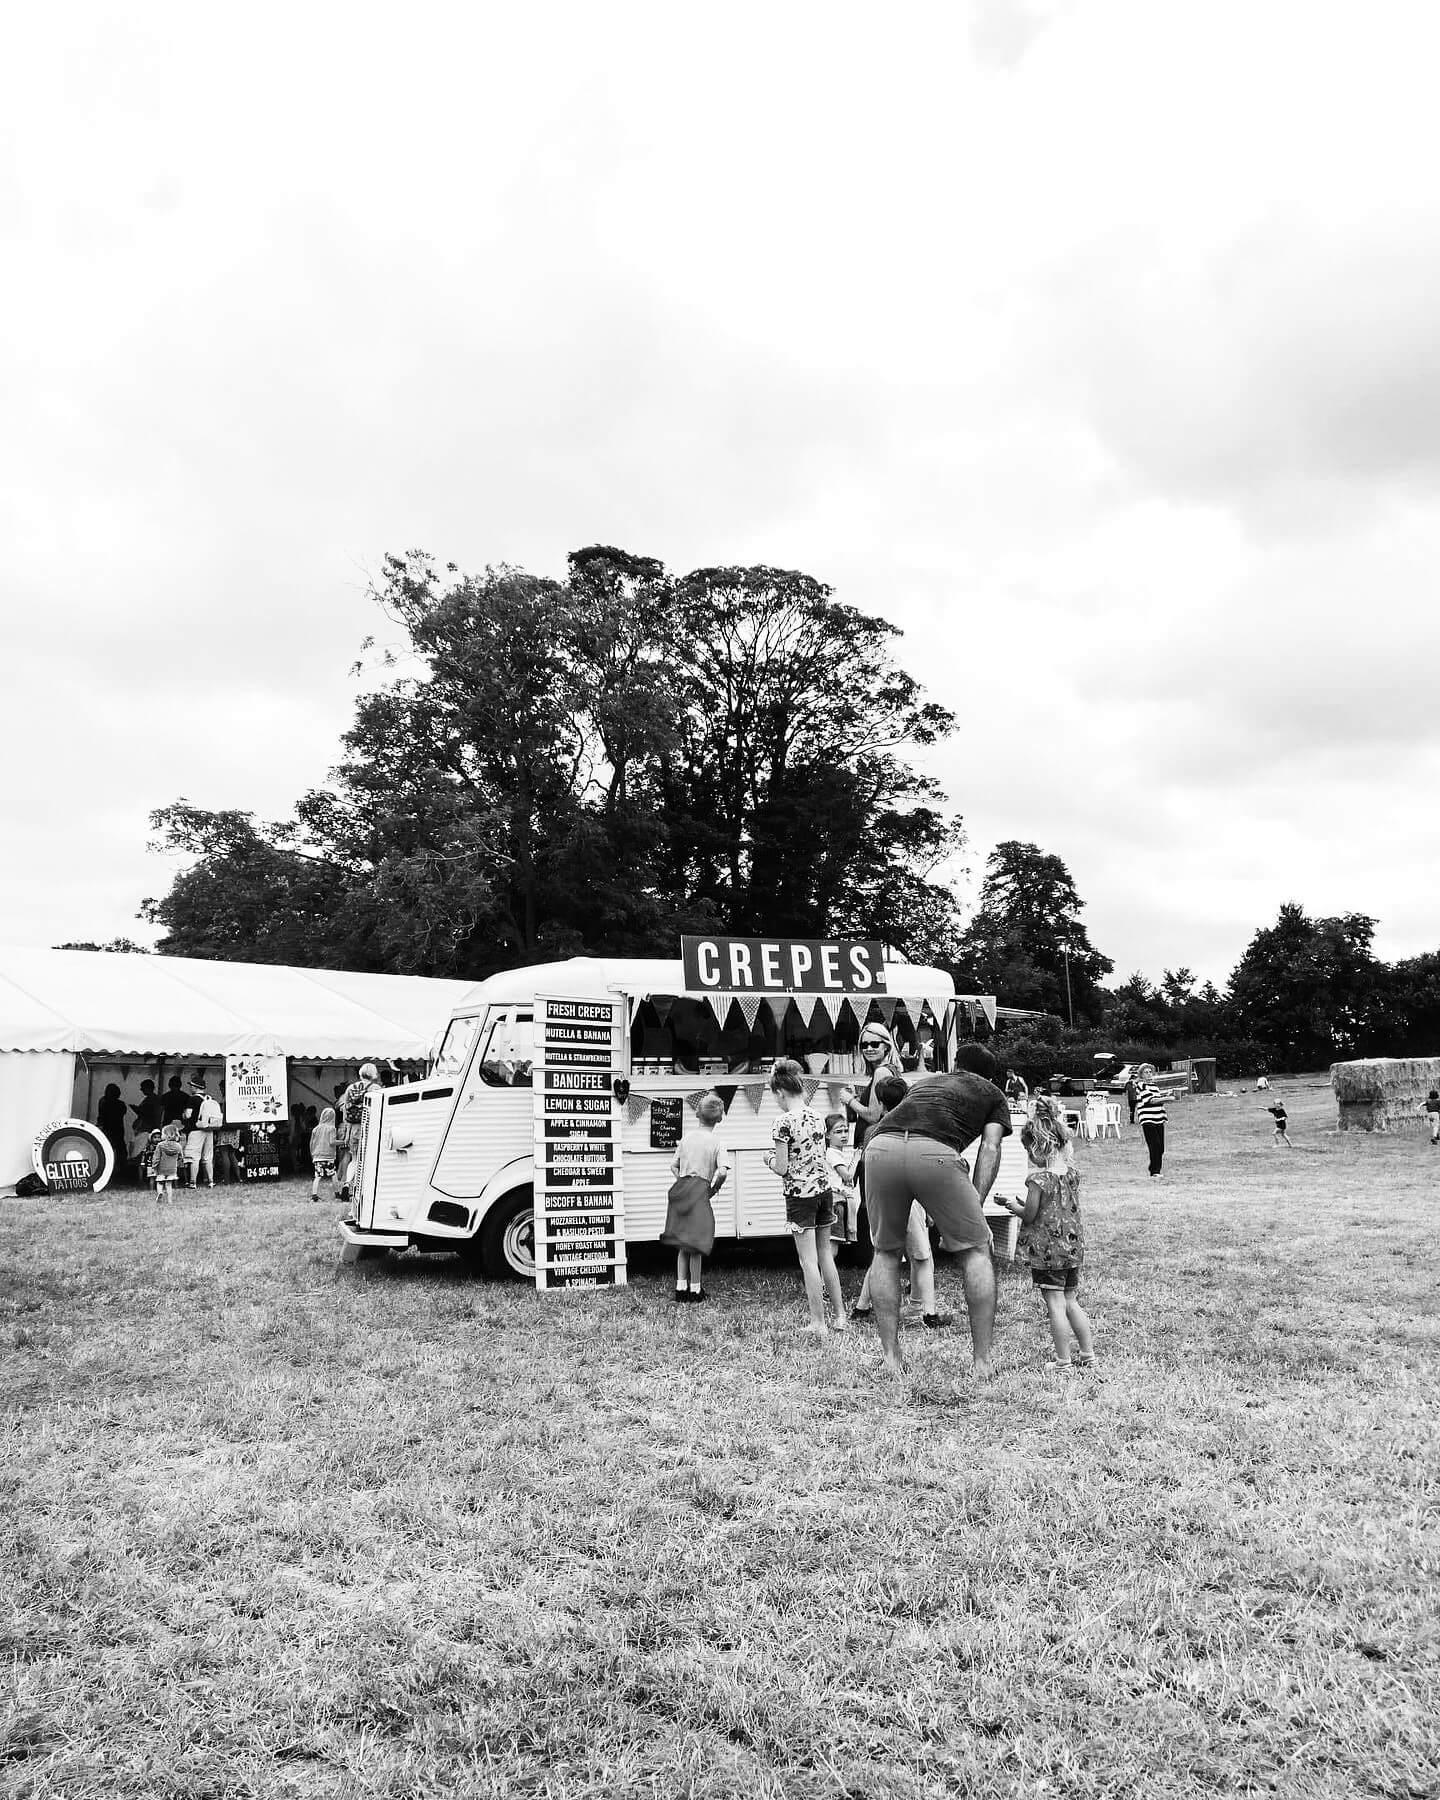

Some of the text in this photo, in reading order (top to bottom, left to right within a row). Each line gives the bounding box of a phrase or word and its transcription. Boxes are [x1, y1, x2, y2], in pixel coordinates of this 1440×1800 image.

[698, 942, 872, 989] CREPES
[548, 1003, 611, 1018] FRESH CREPES
[546, 1028, 611, 1040] NUTELLA & BANANA
[245, 1075, 264, 1085] amy
[553, 1073, 603, 1088] BANOFFEE
[238, 1085, 272, 1096] maxine
[546, 1099, 610, 1111] LEMON & SUGAR
[551, 1119, 568, 1127] APPLE
[575, 1119, 606, 1127] CINNAMON
[33, 1120, 62, 1147] ARCHERY
[553, 1143, 583, 1151] RASPBERRY
[589, 1143, 606, 1151] WHITE
[553, 1154, 583, 1162] CHOCOLATE
[46, 1161, 90, 1180] GLITTER
[553, 1167, 605, 1175] CHEDDAR & SWEET
[53, 1178, 88, 1190] TATTOOS
[545, 1195, 613, 1207] BISCOFF & BANANA
[550, 1216, 611, 1225] MOZZARELLA, TOMATO
[562, 1228, 587, 1236] BASILICO
[587, 1227, 605, 1235] PESTO
[555, 1241, 606, 1251] HONEY ROAST HAM
[559, 1253, 582, 1262] VINTAGE
[583, 1252, 608, 1260] CHEDDAR
[554, 1266, 607, 1276] VINTAGE CHEDDAR
[571, 1277, 597, 1287] SPINACH
